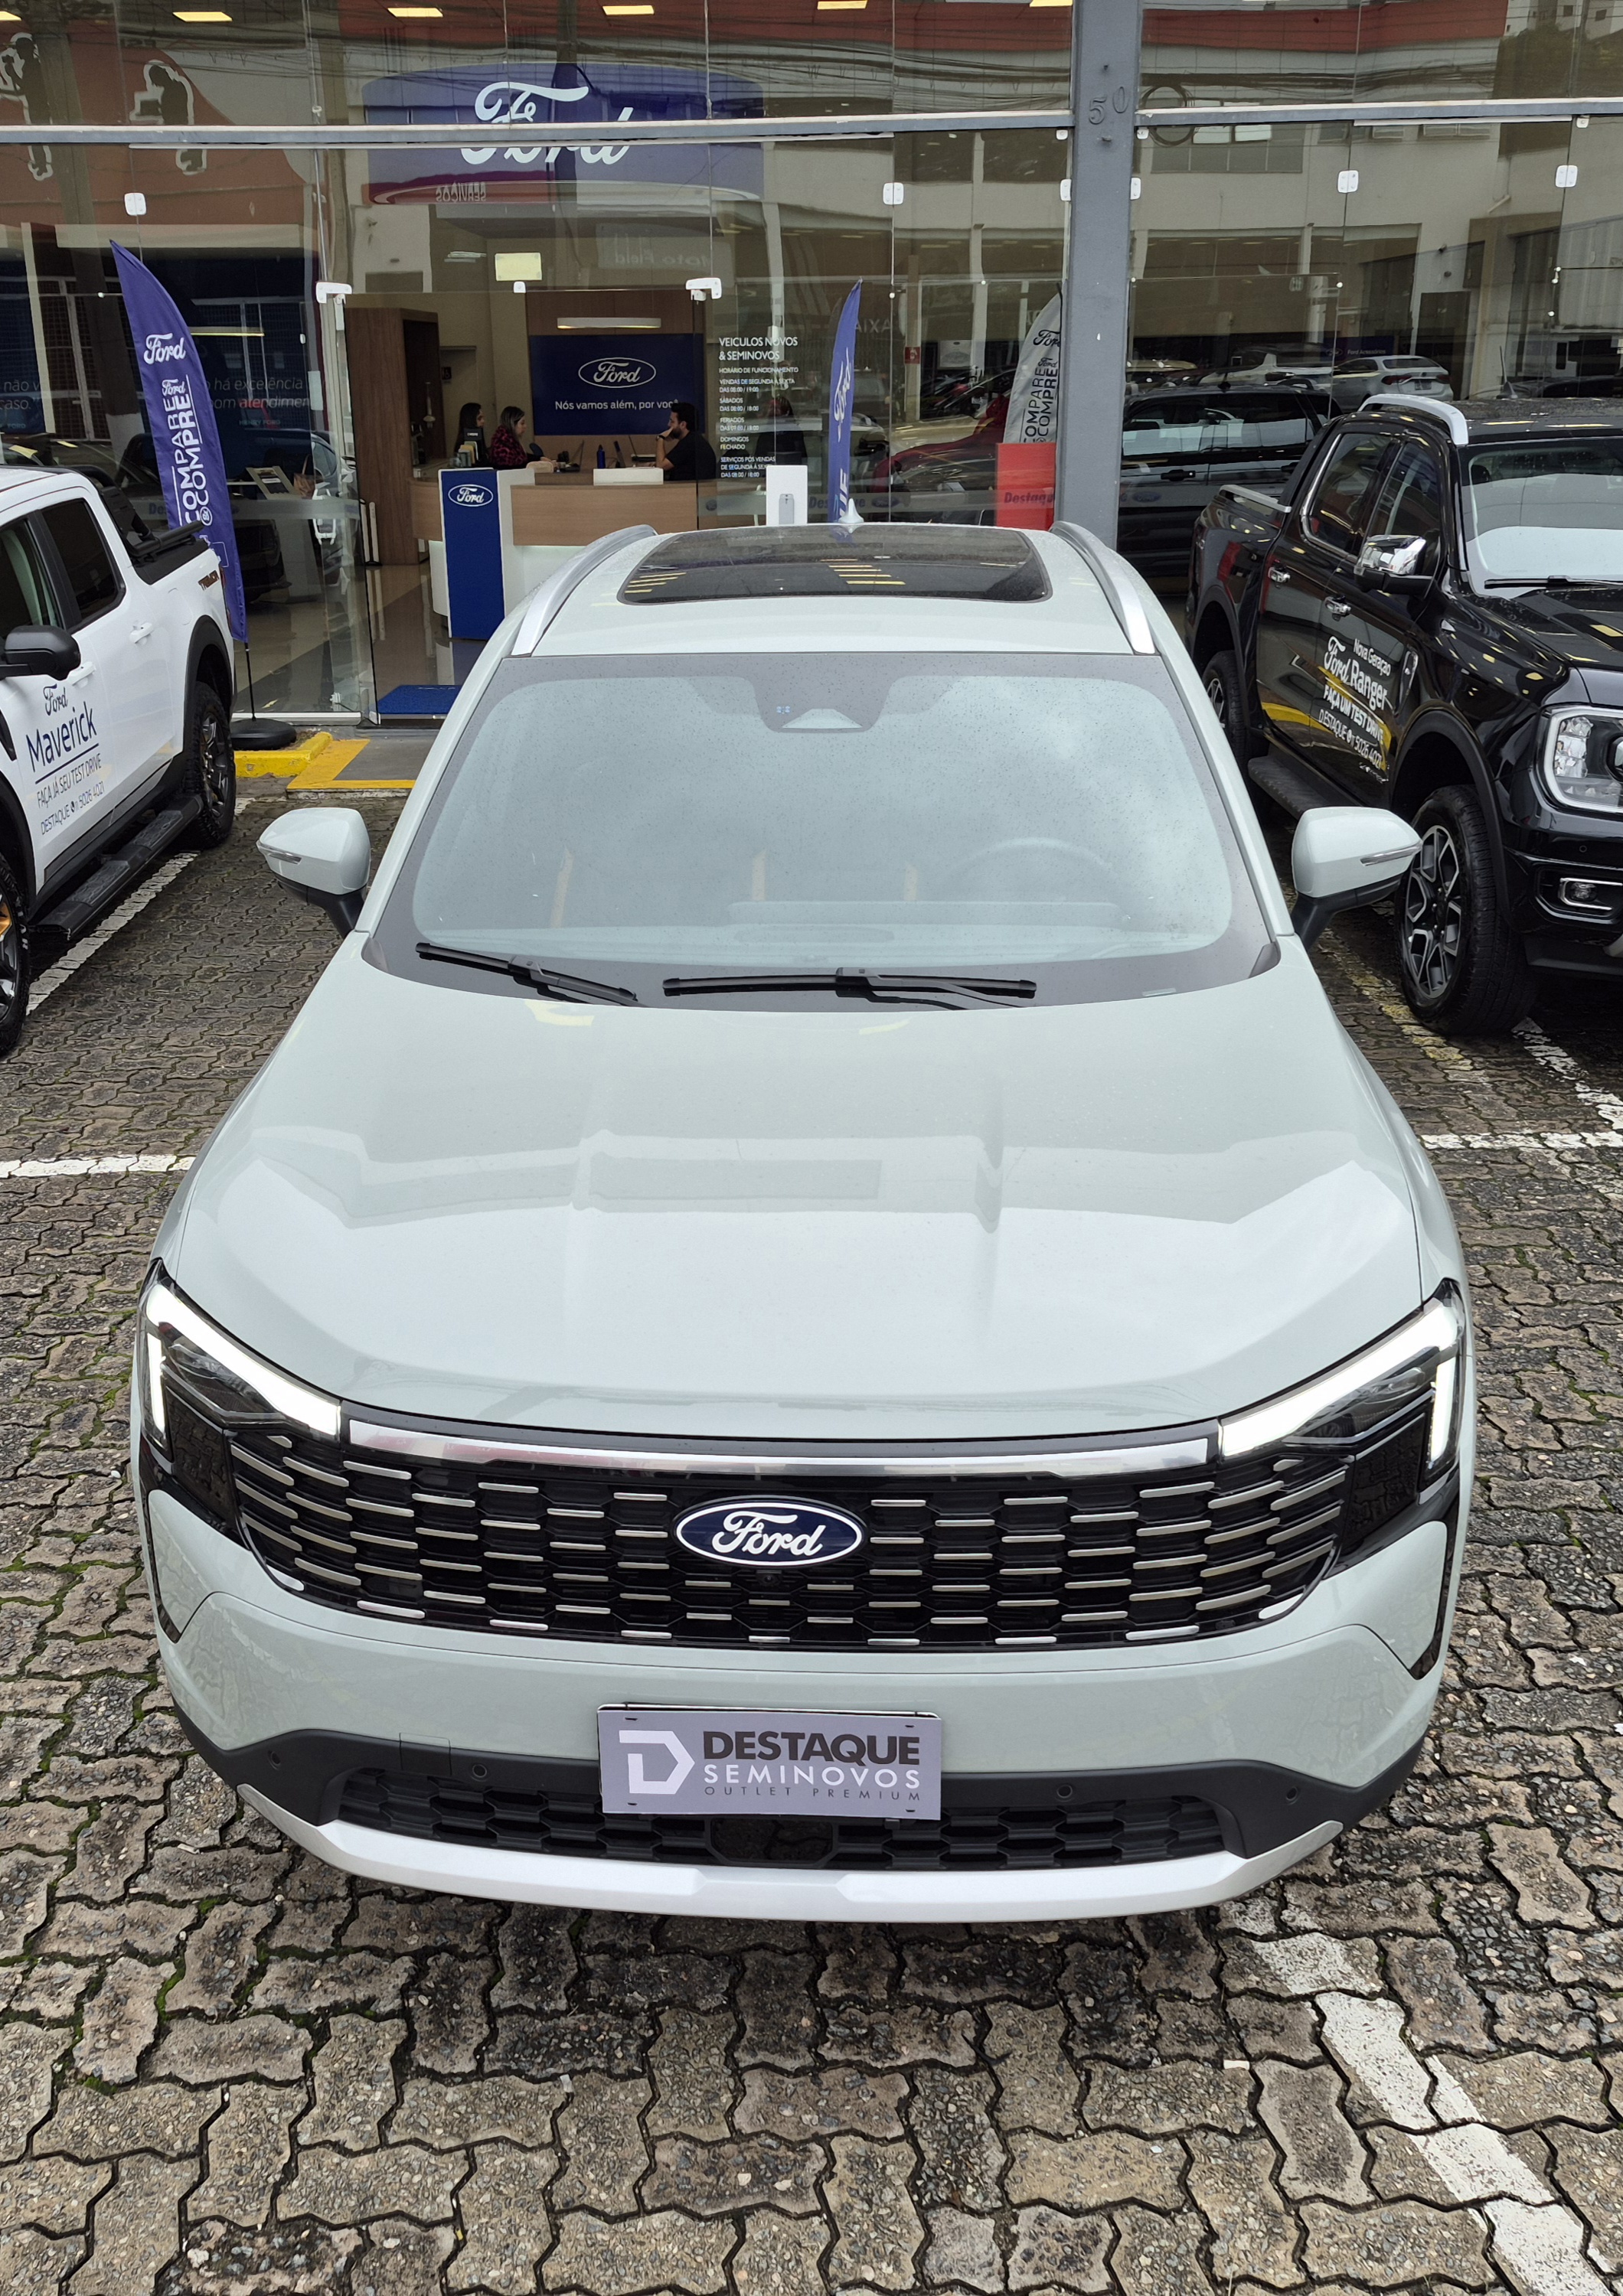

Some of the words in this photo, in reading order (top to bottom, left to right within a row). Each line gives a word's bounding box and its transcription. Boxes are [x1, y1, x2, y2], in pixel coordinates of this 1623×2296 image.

[856, 318, 891, 333] AIXA
[143, 333, 186, 364] Ford
[719, 337, 763, 347] VEICULOS
[766, 337, 798, 347] NOVOS
[719, 351, 726, 360] &
[727, 351, 779, 360] SEMINOVOS
[593, 361, 642, 383] Ford
[1038, 357, 1057, 367] Ford
[4, 380, 29, 392] não
[162, 379, 186, 396] Ford
[212, 398, 236, 409] om
[239, 397, 310, 409] atendimen
[555, 401, 574, 410] Nós
[610, 400, 637, 410] além,
[638, 401, 655, 410] por
[657, 400, 678, 409] voc
[1024, 368, 1047, 442] OMPARE
[1037, 368, 1058, 436] COMPRE
[163, 397, 201, 523] COMPARE
[175, 393, 209, 506] COMPRE
[456, 486, 485, 504] Ford
[1004, 492, 1054, 505] Destaqu
[1354, 638, 1368, 660] Nova
[1324, 636, 1352, 683] Ford
[1350, 660, 1388, 710] Ranger
[43, 683, 68, 716] Ford
[1324, 684, 1340, 709] FAÇA
[1340, 696, 1351, 716] UM
[1350, 703, 1367, 729] TEST
[1366, 716, 1383, 745] DRIVE
[26, 701, 96, 772] Maverick
[1318, 709, 1347, 740] DESTAQUE
[1354, 735, 1369, 758] 5026
[37, 785, 53, 808] FAÇA
[60, 772, 70, 793] SEU
[71, 763, 84, 785] TEST
[86, 753, 101, 777] DRIVE
[41, 804, 70, 835] DESTAQUE
[79, 789, 92, 808] 5026
[93, 781, 105, 797] 4021
[712, 1511, 826, 1556] Ford
[703, 1730, 920, 1766] DESTAQUE
[704, 1763, 920, 1789] SEMINOVOS
[704, 1786, 792, 1797] OUTLET
[812, 1787, 920, 1802] PREMIUM
